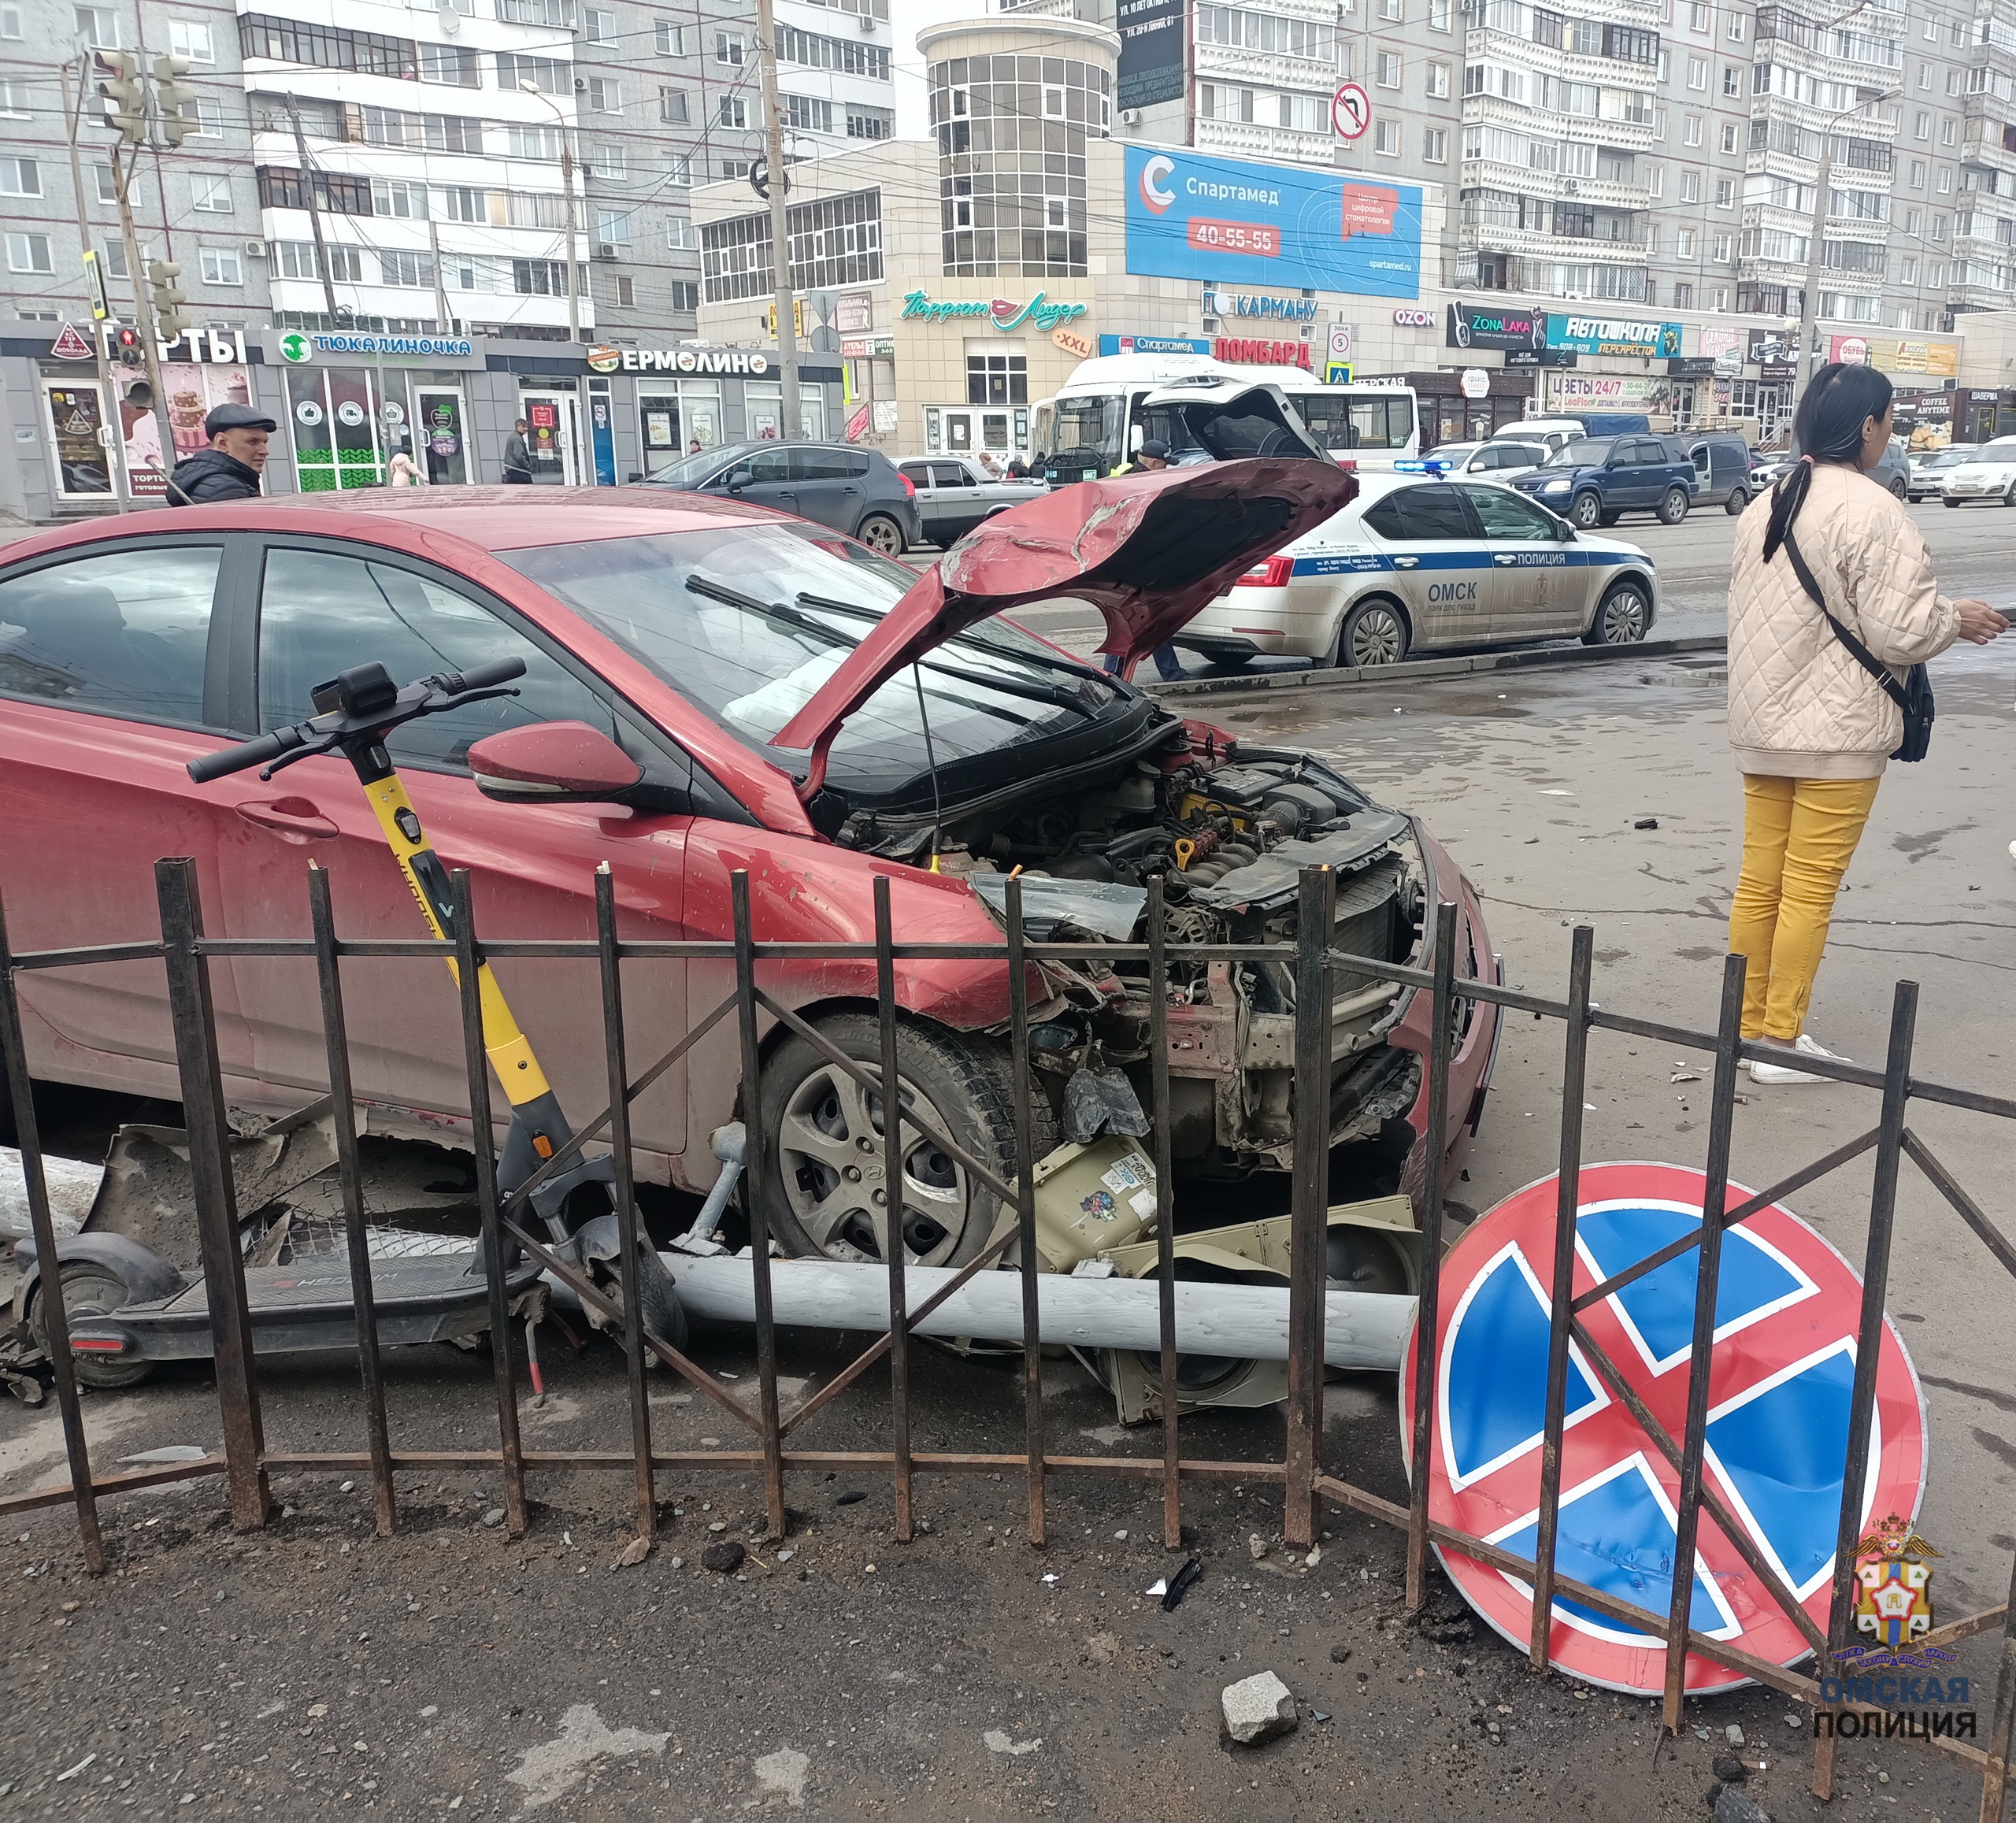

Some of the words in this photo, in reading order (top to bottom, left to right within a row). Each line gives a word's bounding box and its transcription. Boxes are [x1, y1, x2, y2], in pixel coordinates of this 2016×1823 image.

[1120, 5, 1129, 17] УЛ.
[1130, 2, 1136, 13] 10
[1136, 0, 1147, 12] ЛЕТ
[1186, 176, 1280, 206] Спартамед
[1358, 192, 1379, 205] Центр
[1351, 203, 1384, 214] цифровой
[1345, 213, 1391, 225] стоматологии
[1196, 224, 1272, 250] 40-55-55
[1369, 260, 1412, 272] spartamed.ru
[901, 288, 989, 323] Парфюм
[991, 290, 1088, 332] Лидер
[1236, 294, 1318, 321] КАРМАНУ
[1394, 309, 1436, 327] OZON
[1565, 317, 1661, 343] АВТОШКОЛА
[1706, 328, 1735, 344] СЕКОНД
[313, 335, 472, 356] ТЮКАЛИНОЧКА
[843, 341, 865, 350] АТЕЛЬЕ
[1060, 333, 1087, 354] XXL
[1136, 337, 1194, 353] Спартамед
[1597, 343, 1657, 356] ПЕРЕКРЁСТОК
[1706, 344, 1726, 357] ХЕНД
[1843, 345, 1865, 354] ОБУВЬ
[1213, 338, 1310, 369] ЛОМБАРД
[621, 350, 768, 374] ЕРМОЛИНО
[1788, 367, 1796, 376] 79
[1595, 380, 1621, 395] 24/7
[1971, 391, 1998, 400] ШАВЕРМА
[1565, 397, 1592, 406] LeaFlor
[1518, 554, 1566, 566] ПОЛИЦИЯ
[1429, 582, 1477, 602] ОМСК
